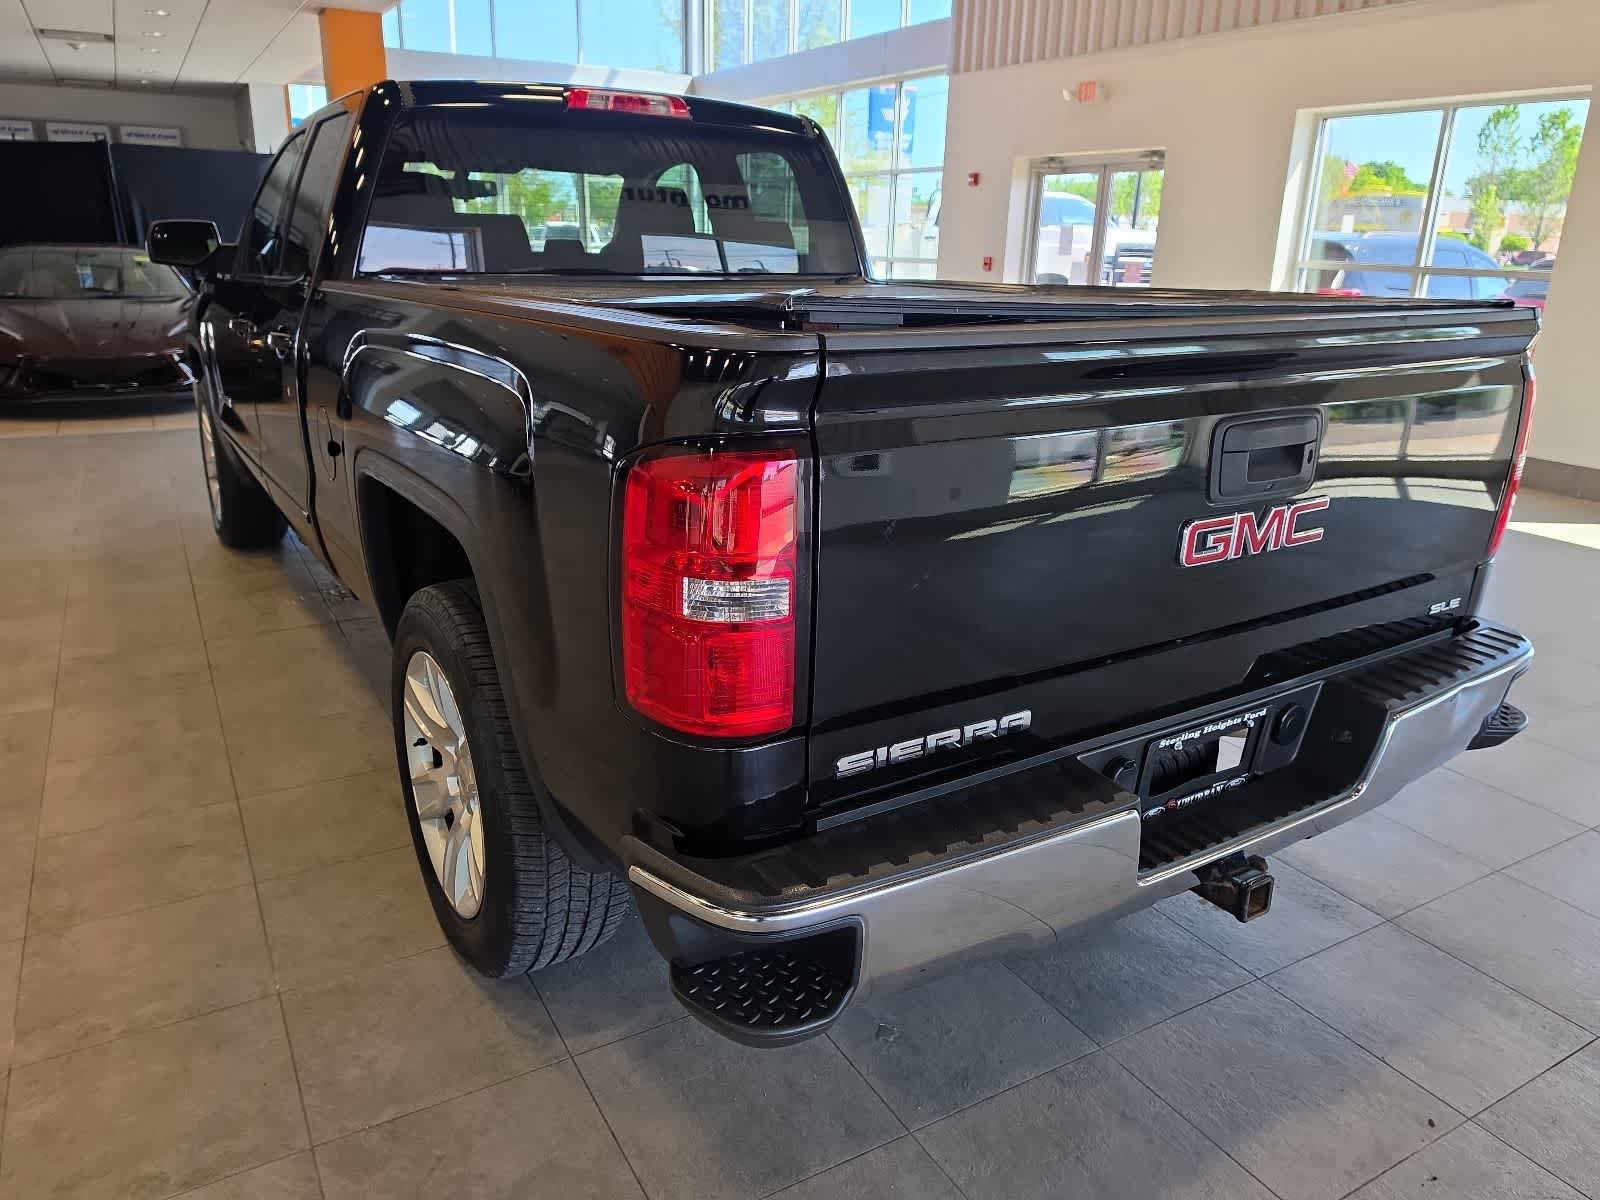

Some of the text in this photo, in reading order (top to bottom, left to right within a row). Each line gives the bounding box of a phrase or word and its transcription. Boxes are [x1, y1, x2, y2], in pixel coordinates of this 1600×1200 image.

[1180, 496, 1331, 567] GMC
[1428, 598, 1462, 615] SLE
[835, 710, 1032, 779] SIERRA
[1159, 708, 1267, 748] Sterling Heights Ford
